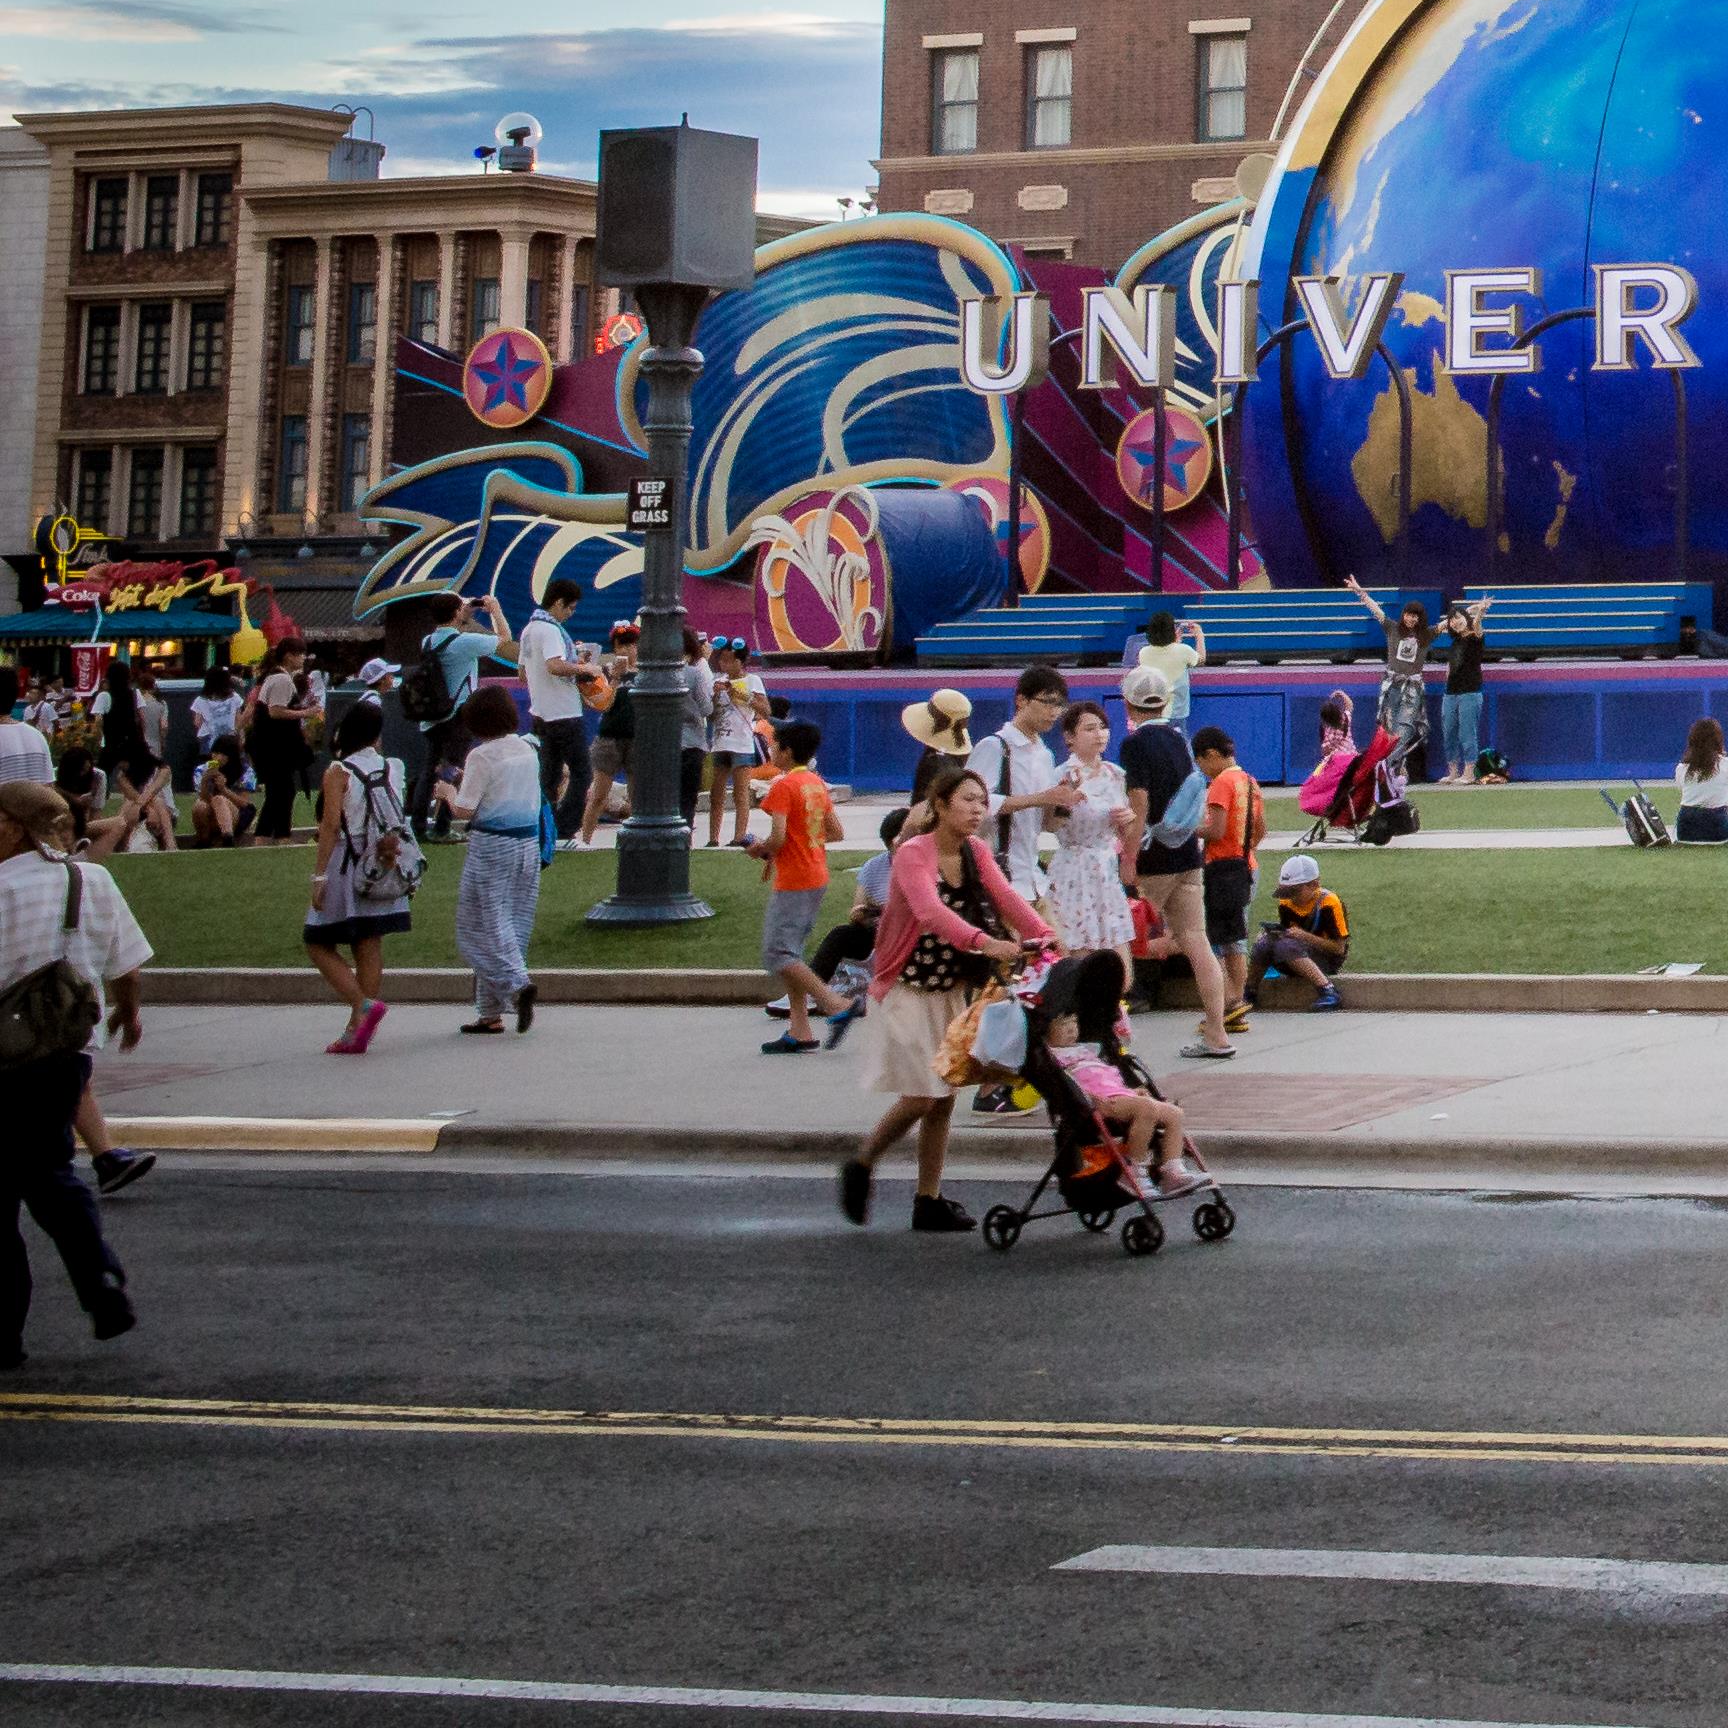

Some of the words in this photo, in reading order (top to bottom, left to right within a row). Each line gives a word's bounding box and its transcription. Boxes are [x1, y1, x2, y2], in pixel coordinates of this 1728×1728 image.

[637, 481, 666, 494] KEEP
[640, 495, 662, 508] OFF
[632, 509, 669, 523] GRASS
[62, 589, 99, 602] Coke
